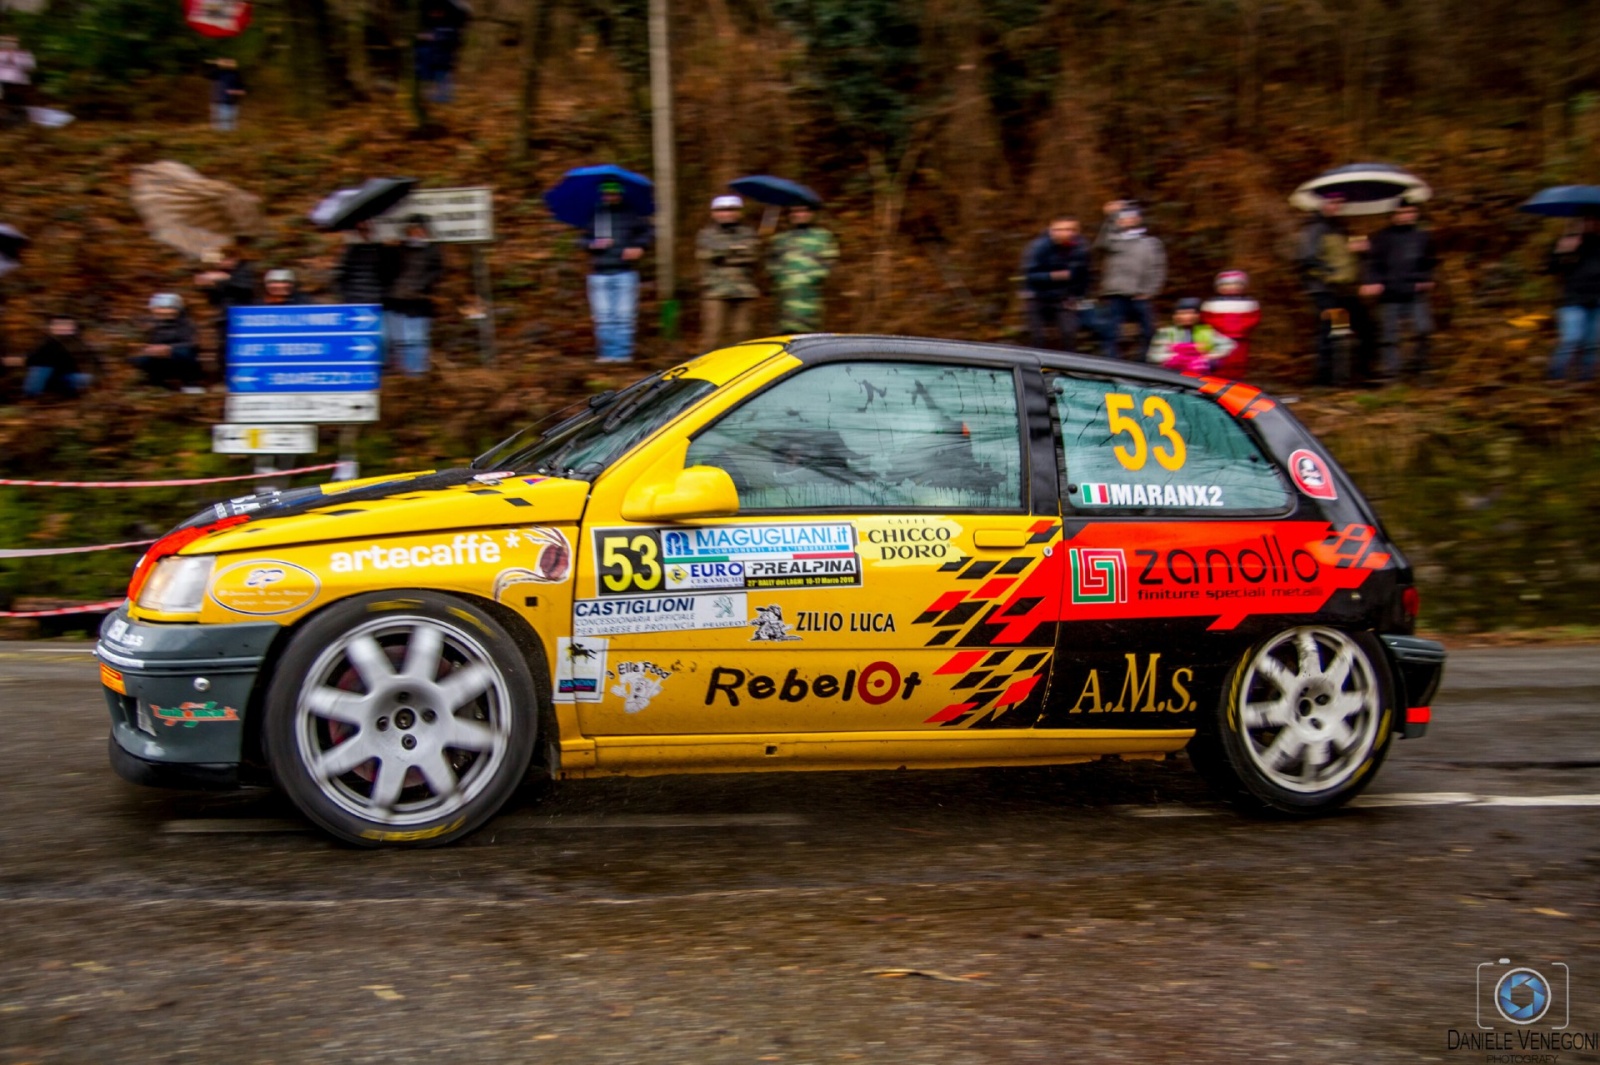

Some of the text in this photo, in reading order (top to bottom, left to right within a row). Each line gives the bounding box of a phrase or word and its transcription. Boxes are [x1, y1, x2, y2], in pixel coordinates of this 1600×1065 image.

[1105, 393, 1187, 471] 53
[1110, 483, 1224, 506] MARANX2
[696, 527, 848, 548] MAGUGLIANI.it
[868, 527, 951, 544] CHICCO
[880, 544, 947, 560] D'ORO
[1135, 534, 1320, 585] zanollo
[602, 535, 662, 591] 53
[691, 562, 743, 577] EURO
[752, 560, 854, 575] PREALPINA
[1137, 588, 1199, 601] finiture
[1205, 586, 1266, 600] speciali
[575, 597, 695, 617] CASTIGLIONI
[702, 620, 746, 628] PEUGEOT
[796, 611, 896, 632] ZILIO LUCA
